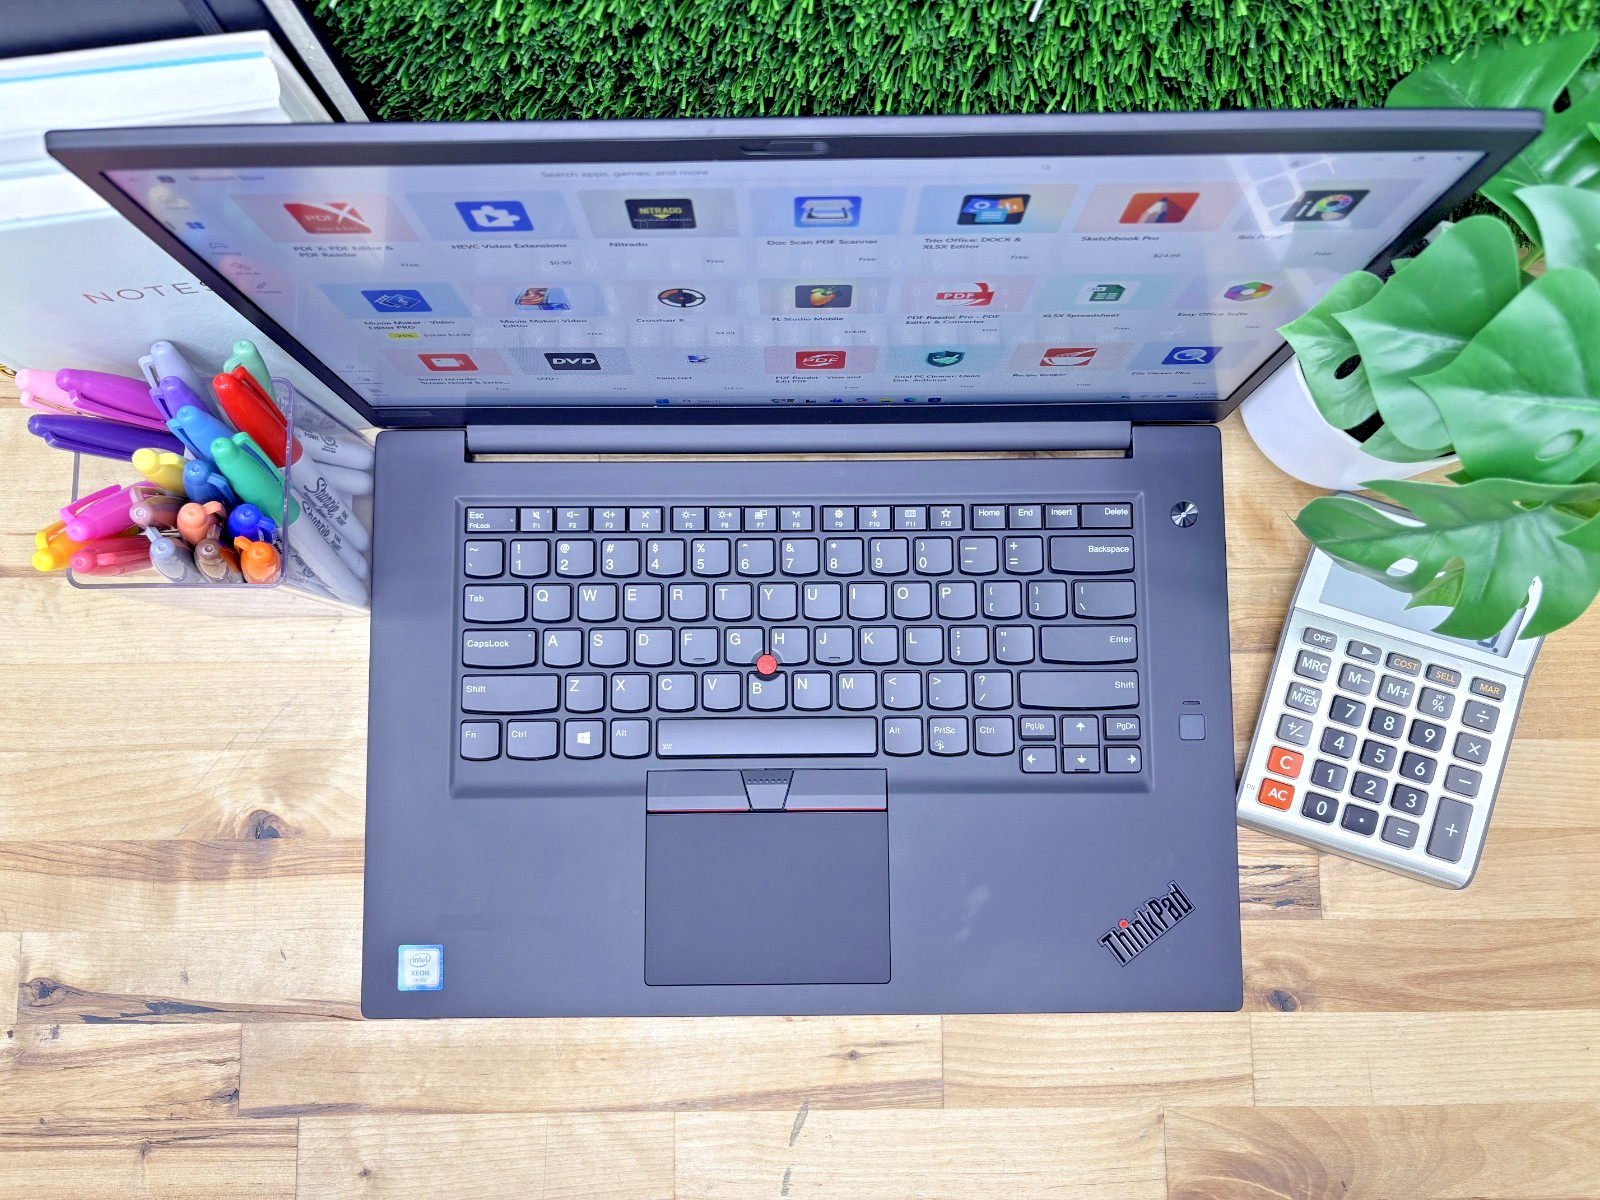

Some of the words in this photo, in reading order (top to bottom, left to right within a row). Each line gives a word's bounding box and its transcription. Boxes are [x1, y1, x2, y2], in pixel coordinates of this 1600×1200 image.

[552, 355, 596, 368] DVD
[304, 477, 340, 519] Sharpie
[1051, 508, 1072, 516] Insert
[516, 560, 522, 570] 1
[560, 560, 568, 570] 2
[606, 560, 614, 570] 3
[651, 559, 659, 570] 4
[697, 559, 705, 570] 5
[741, 559, 749, 569] 6
[786, 559, 793, 569] 7
[830, 558, 838, 569] 8
[875, 558, 883, 569] 9
[919, 558, 927, 568] 0
[537, 590, 548, 602] Q
[583, 590, 597, 601] W
[628, 589, 637, 600] E
[673, 589, 683, 600] R
[719, 589, 728, 599] T
[764, 589, 773, 599] Y
[808, 589, 817, 600] U
[897, 588, 908, 599] O
[942, 588, 951, 598] P
[548, 635, 558, 646] A
[593, 635, 603, 646] S
[639, 635, 649, 646] D
[684, 634, 693, 645] F
[730, 633, 741, 645] G
[775, 633, 785, 644] H
[820, 633, 827, 644] J
[864, 633, 874, 644] K
[909, 633, 917, 643] L
[1313, 633, 1331, 644] OFF
[467, 640, 509, 648] CapsLock
[1302, 657, 1328, 674] MRC
[1394, 659, 1419, 670] COST
[1435, 671, 1456, 683] SELL
[569, 680, 579, 691] Z
[616, 680, 626, 691] X
[661, 679, 672, 691] C
[708, 679, 717, 690] V
[753, 683, 762, 694] B
[797, 678, 807, 689] N
[842, 678, 854, 689] M
[1114, 681, 1134, 689] Shift
[1479, 683, 1500, 695] MAR
[1387, 683, 1410, 699] M+
[1291, 691, 1319, 709] M/EX
[1345, 705, 1356, 718] 7
[1384, 716, 1394, 731] 8
[511, 730, 527, 738] Ctrl
[616, 729, 627, 737] Alt
[1425, 728, 1435, 743] 9
[1333, 736, 1345, 750] 4
[1375, 749, 1386, 763] 5
[1279, 756, 1292, 770] C
[1415, 762, 1425, 776] 6
[1326, 769, 1334, 782] 1
[1365, 780, 1376, 795] 2
[1268, 787, 1288, 802] AC
[1405, 794, 1416, 808] 3
[1317, 802, 1327, 815] 0
[1099, 882, 1194, 964] ThinkPad
